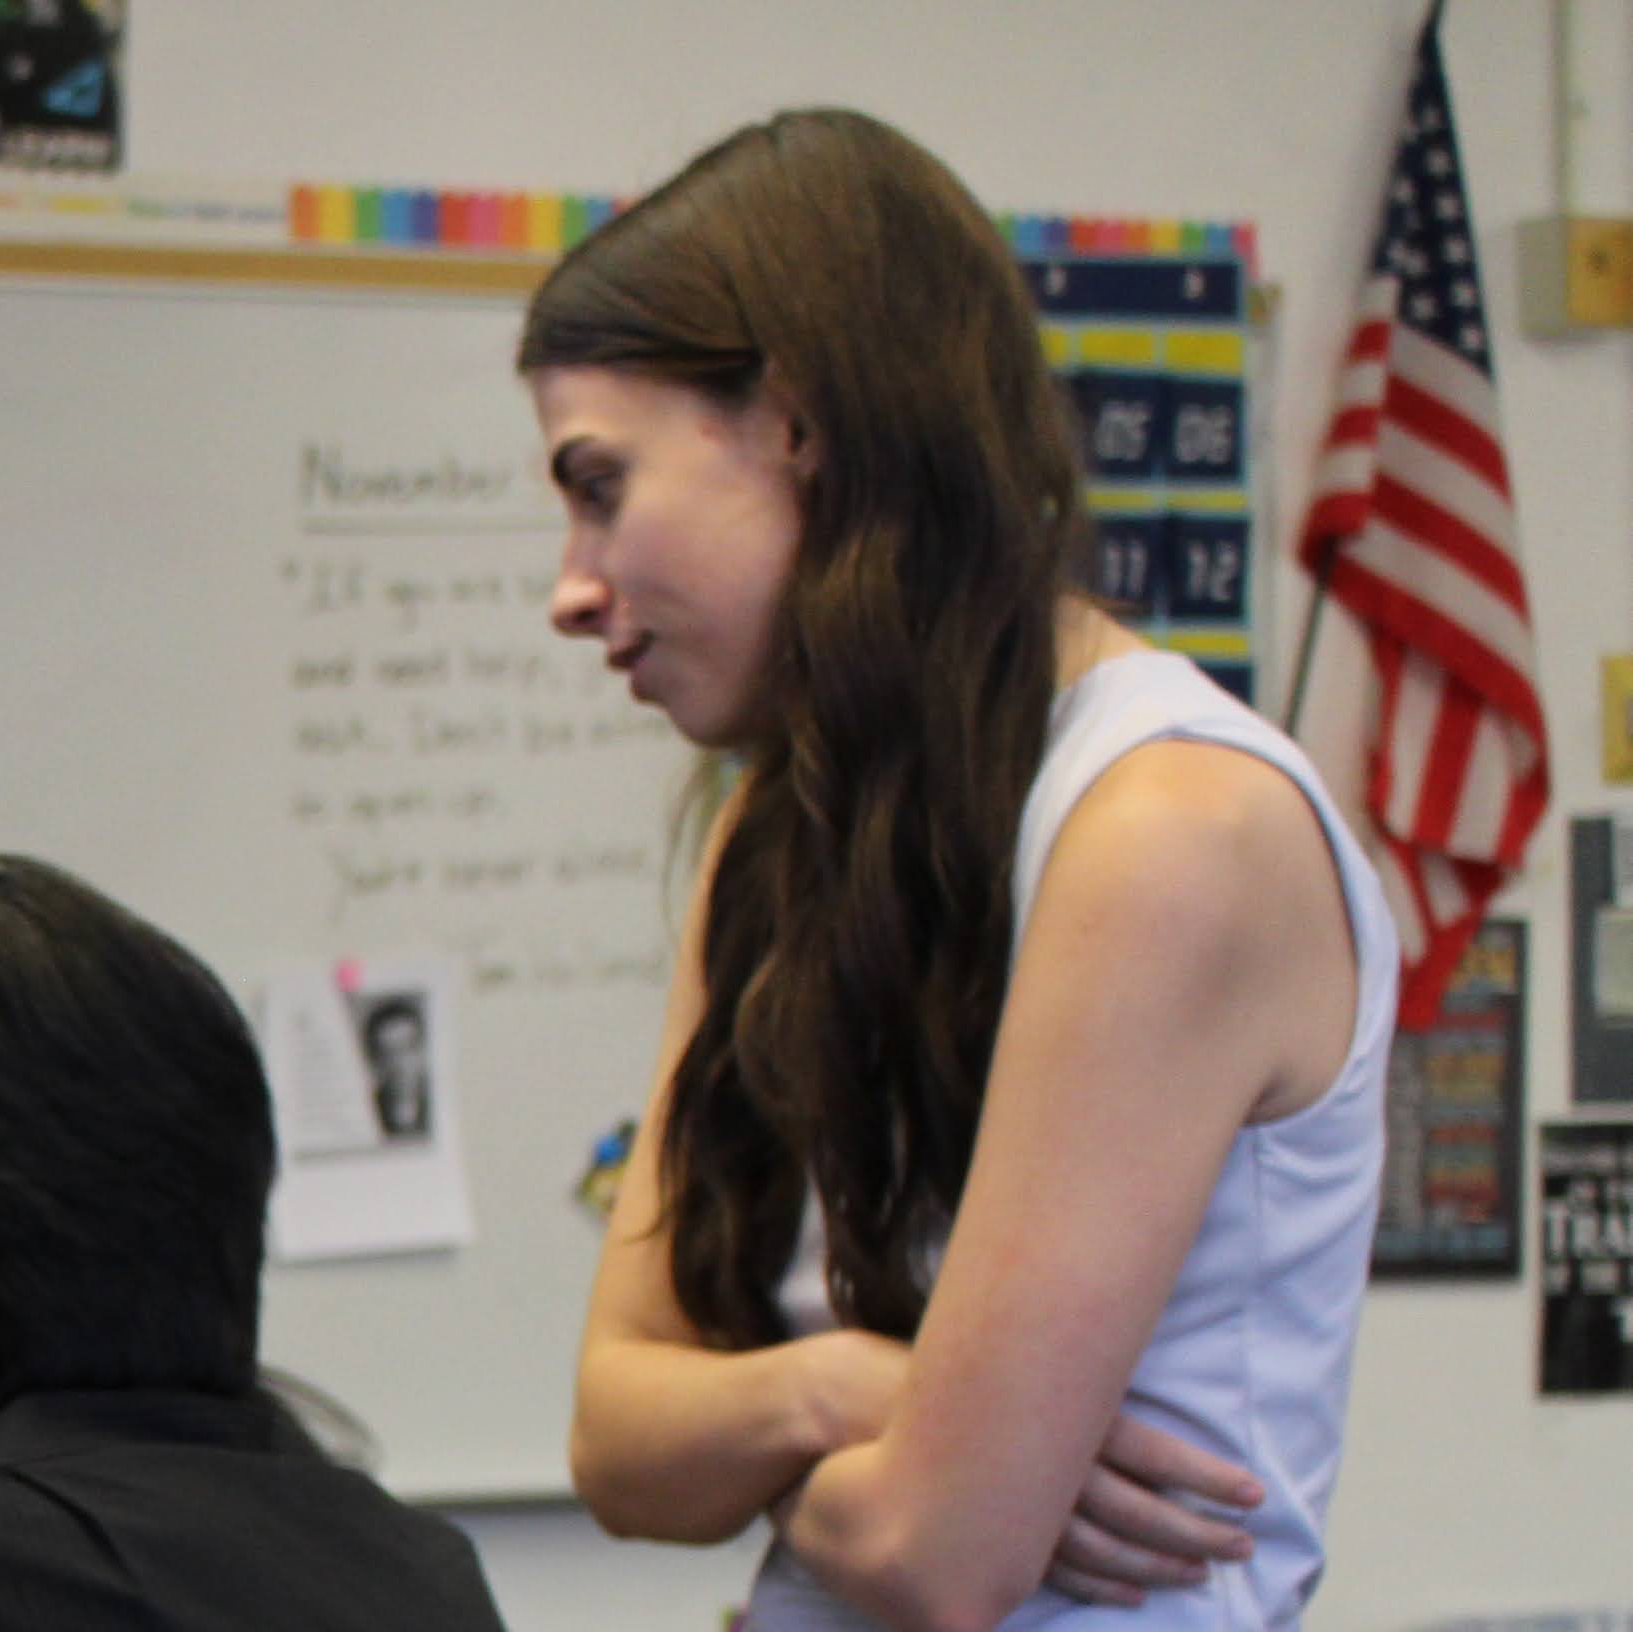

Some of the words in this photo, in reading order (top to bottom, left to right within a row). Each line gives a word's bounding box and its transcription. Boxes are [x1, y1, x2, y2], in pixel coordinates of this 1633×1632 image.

[302, 441, 516, 506] November
[1102, 540, 1148, 598] 11
[1186, 541, 1239, 602] 12
